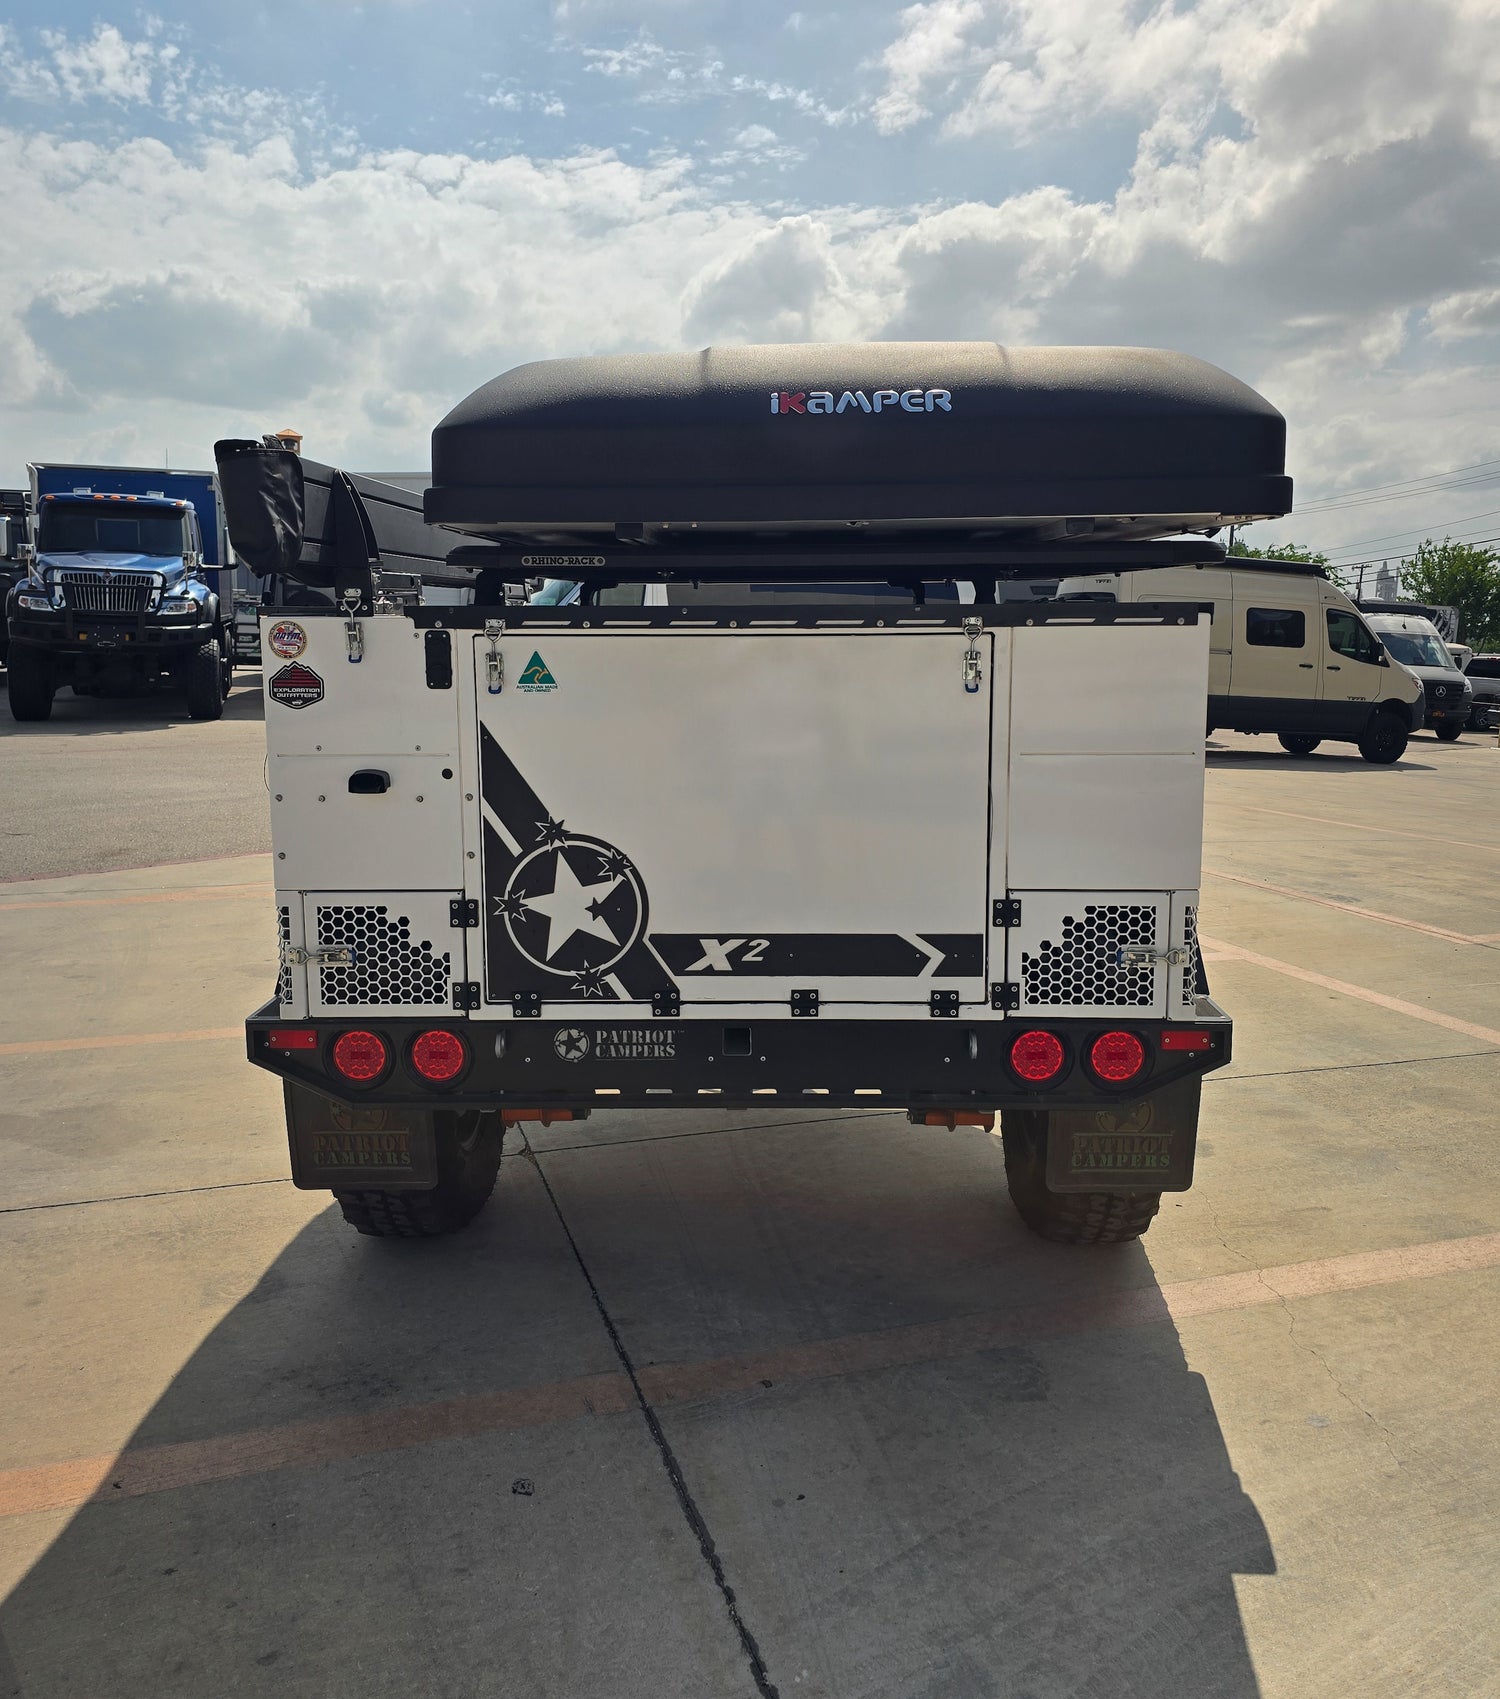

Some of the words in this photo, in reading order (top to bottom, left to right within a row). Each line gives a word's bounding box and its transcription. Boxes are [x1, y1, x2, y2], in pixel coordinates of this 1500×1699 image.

[531, 556, 596, 565] RHINO-RACK
[595, 1030, 676, 1044] PATRIOT
[595, 1044, 676, 1058] CAMPERS
[312, 1134, 409, 1151] PATRIOT
[1072, 1136, 1172, 1153] PATRIOT
[313, 1151, 411, 1165] CAMPERS
[1071, 1153, 1170, 1167] CAMPERS
